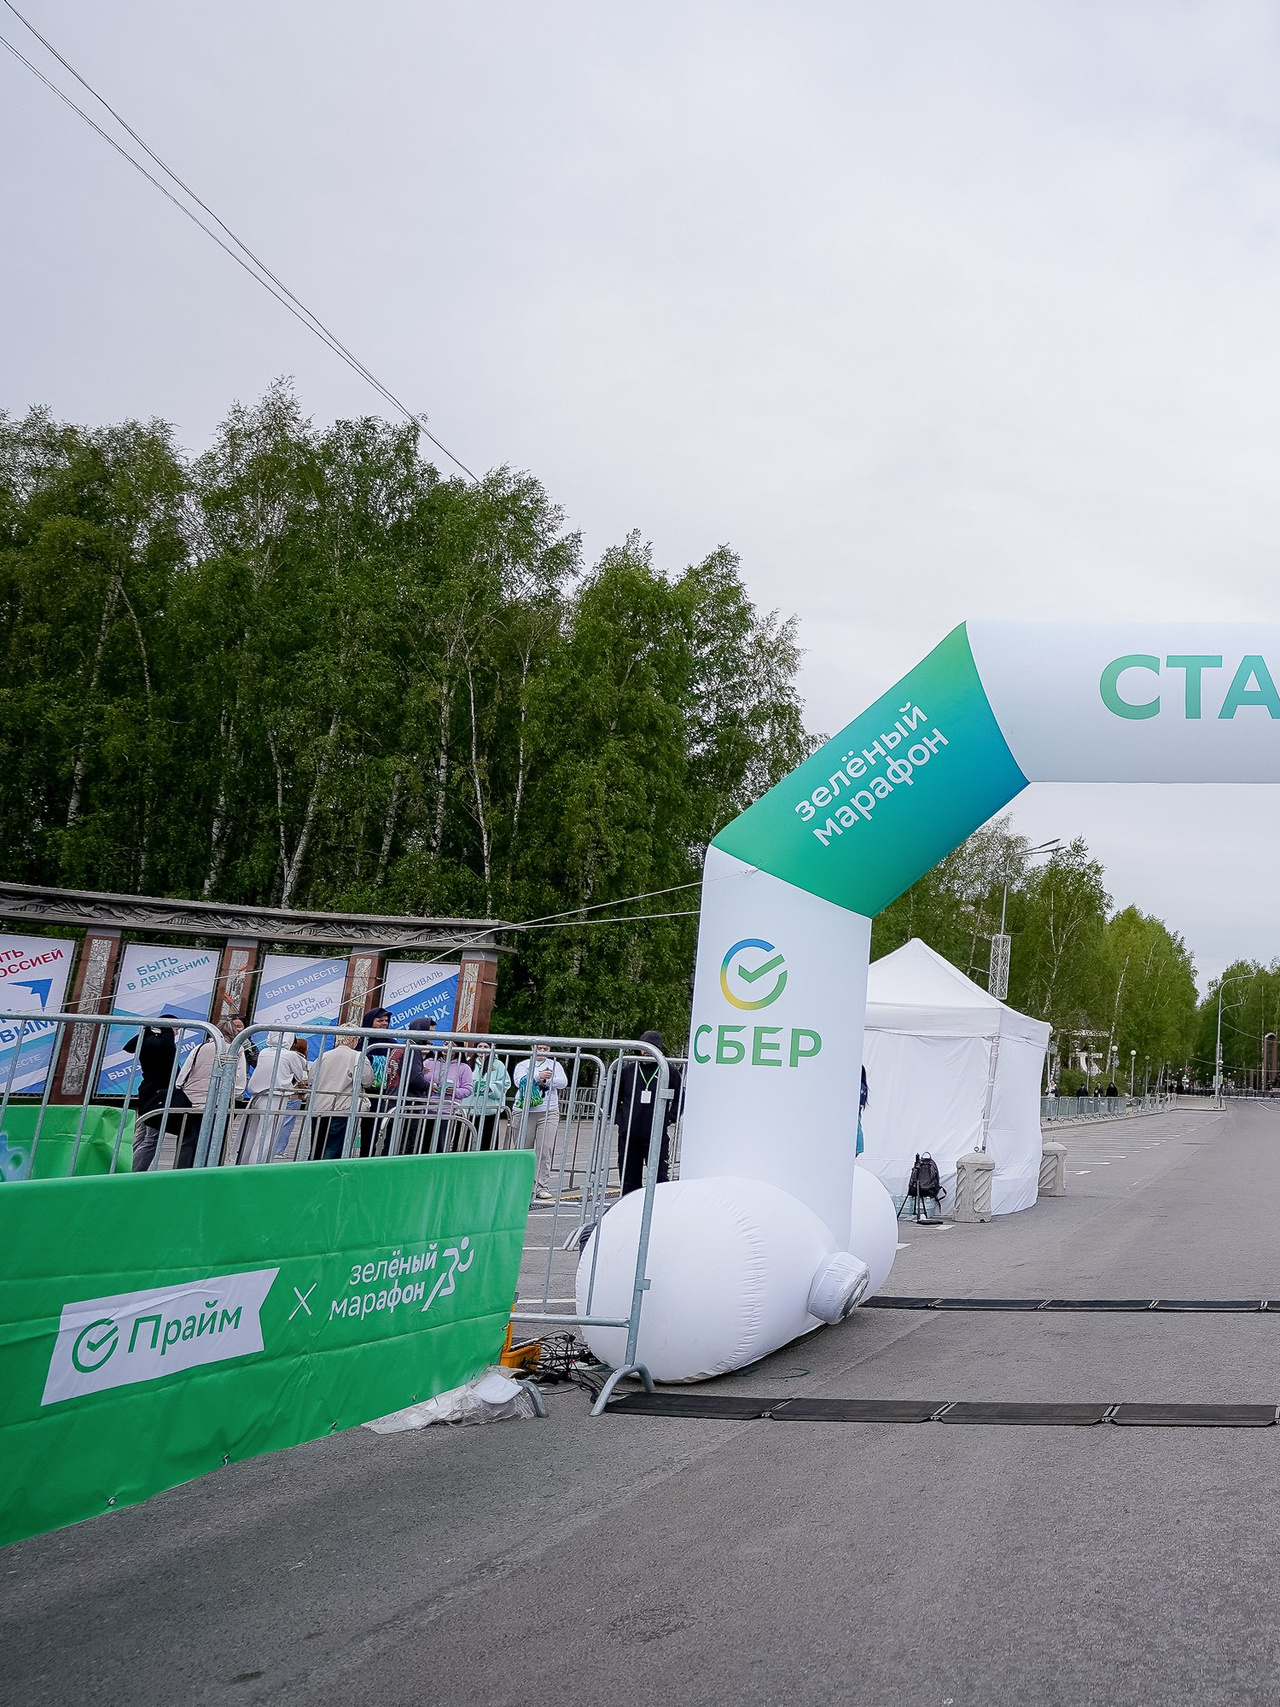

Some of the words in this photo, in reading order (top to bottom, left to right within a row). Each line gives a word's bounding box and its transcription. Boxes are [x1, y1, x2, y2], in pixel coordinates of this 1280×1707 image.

[794, 701, 929, 822] зелёный
[812, 727, 950, 847] марафон
[0, 948, 64, 978] ОССИЕЙ
[126, 982, 136, 991] В
[140, 956, 211, 988] ДВИЖЕНИИ
[136, 957, 179, 976] БЫТЬ
[265, 983, 296, 999] БЫТЬ
[297, 965, 340, 987] ВМЕСТЕ
[389, 970, 444, 999] ФЕСТИВАЛЬ
[284, 997, 334, 1022] РОССИЕЙ
[286, 996, 316, 1012] БЫТЬ
[390, 990, 451, 1027] ДВИЖЕНИЕ
[694, 1024, 822, 1068] СБЕР
[349, 1243, 438, 1286] зелёный
[330, 1279, 425, 1321] марафон
[128, 1301, 241, 1355] Прайм
